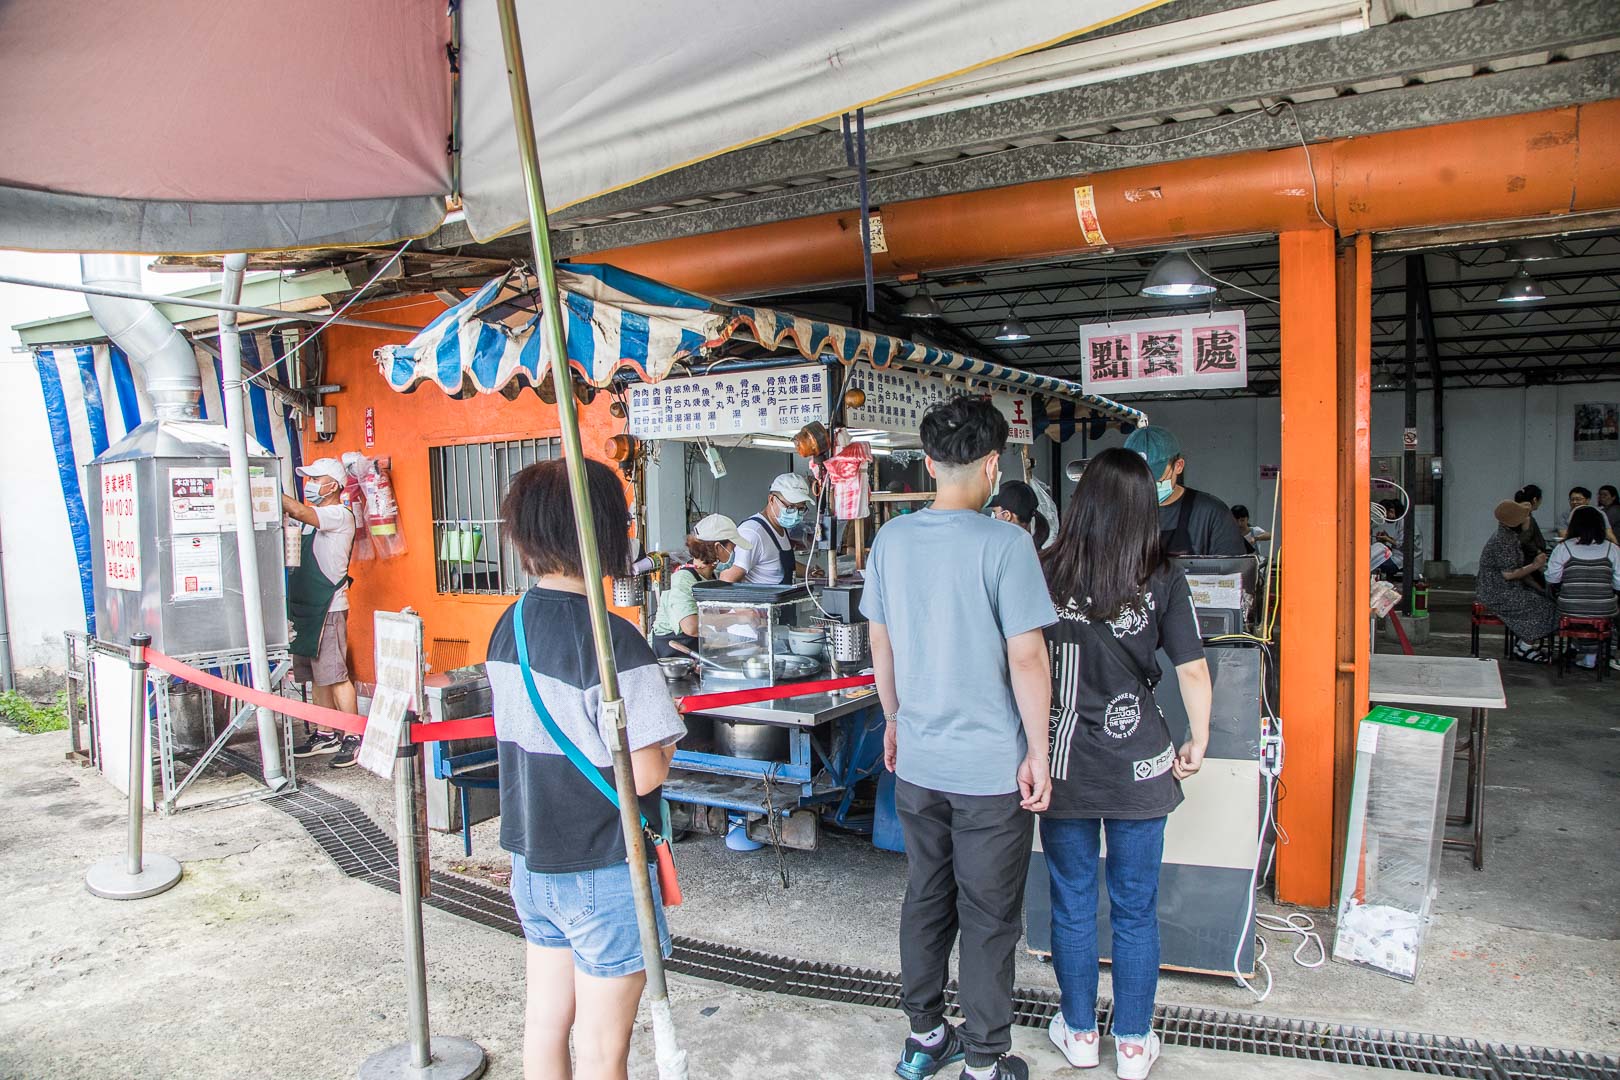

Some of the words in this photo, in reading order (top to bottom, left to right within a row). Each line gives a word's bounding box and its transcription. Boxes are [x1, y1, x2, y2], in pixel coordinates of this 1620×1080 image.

[1091, 329, 1238, 380] 點餐處
[664, 385, 673, 423] 骨仔肉湯
[673, 385, 682, 423] 綜合湯
[682, 384, 692, 422] 魚丸湯
[692, 383, 701, 421] 魚焿湯
[777, 375, 788, 415] 魚丸一斤
[800, 373, 811, 414] 香腸一條
[811, 372, 822, 413] 香腸一斤
[1011, 400, 1029, 425] 王
[105, 473, 133, 494] 營業時間
